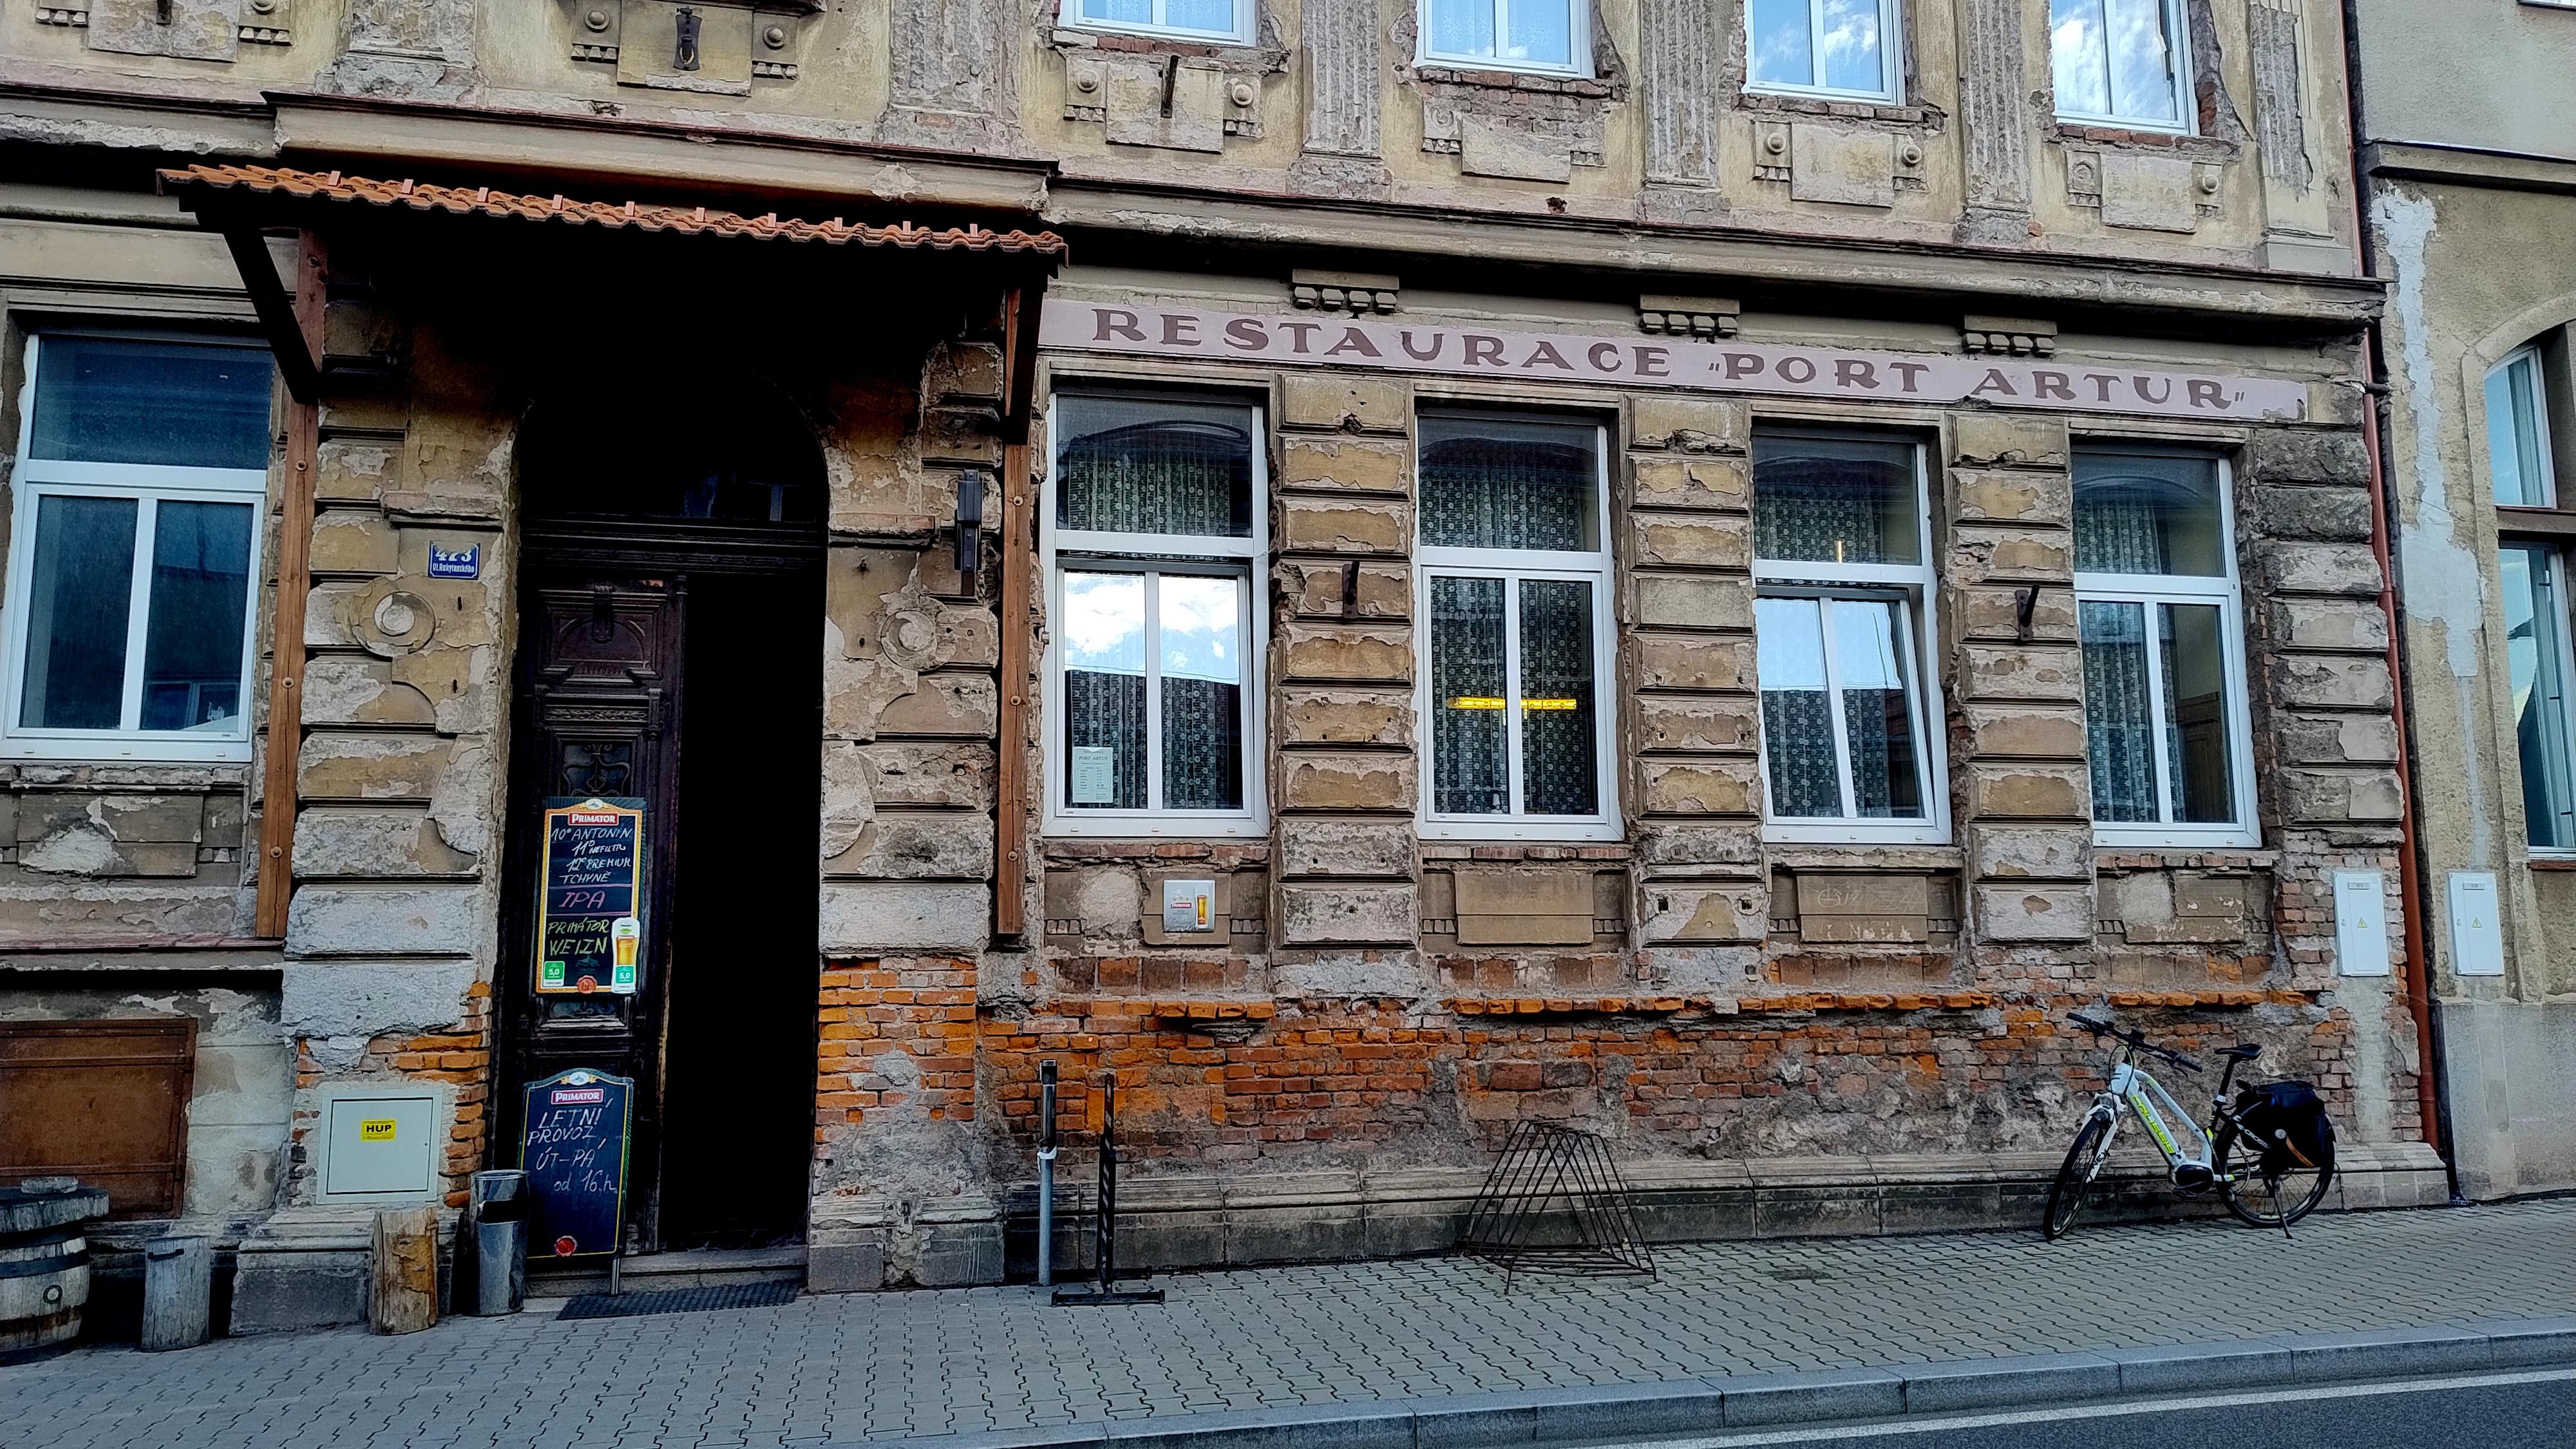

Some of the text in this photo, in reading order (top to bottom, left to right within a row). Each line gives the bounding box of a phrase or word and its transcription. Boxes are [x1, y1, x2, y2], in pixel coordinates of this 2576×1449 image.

[1092, 308, 1671, 377] RESTAURACE
[572, 814, 616, 824] PRIMATOR
[558, 891, 605, 909] IPA
[555, 1092, 600, 1103] PRIMATOR
[366, 1124, 392, 1133] HUP
[527, 1126, 596, 1146] PROVOZ
[554, 1172, 572, 1191] od
